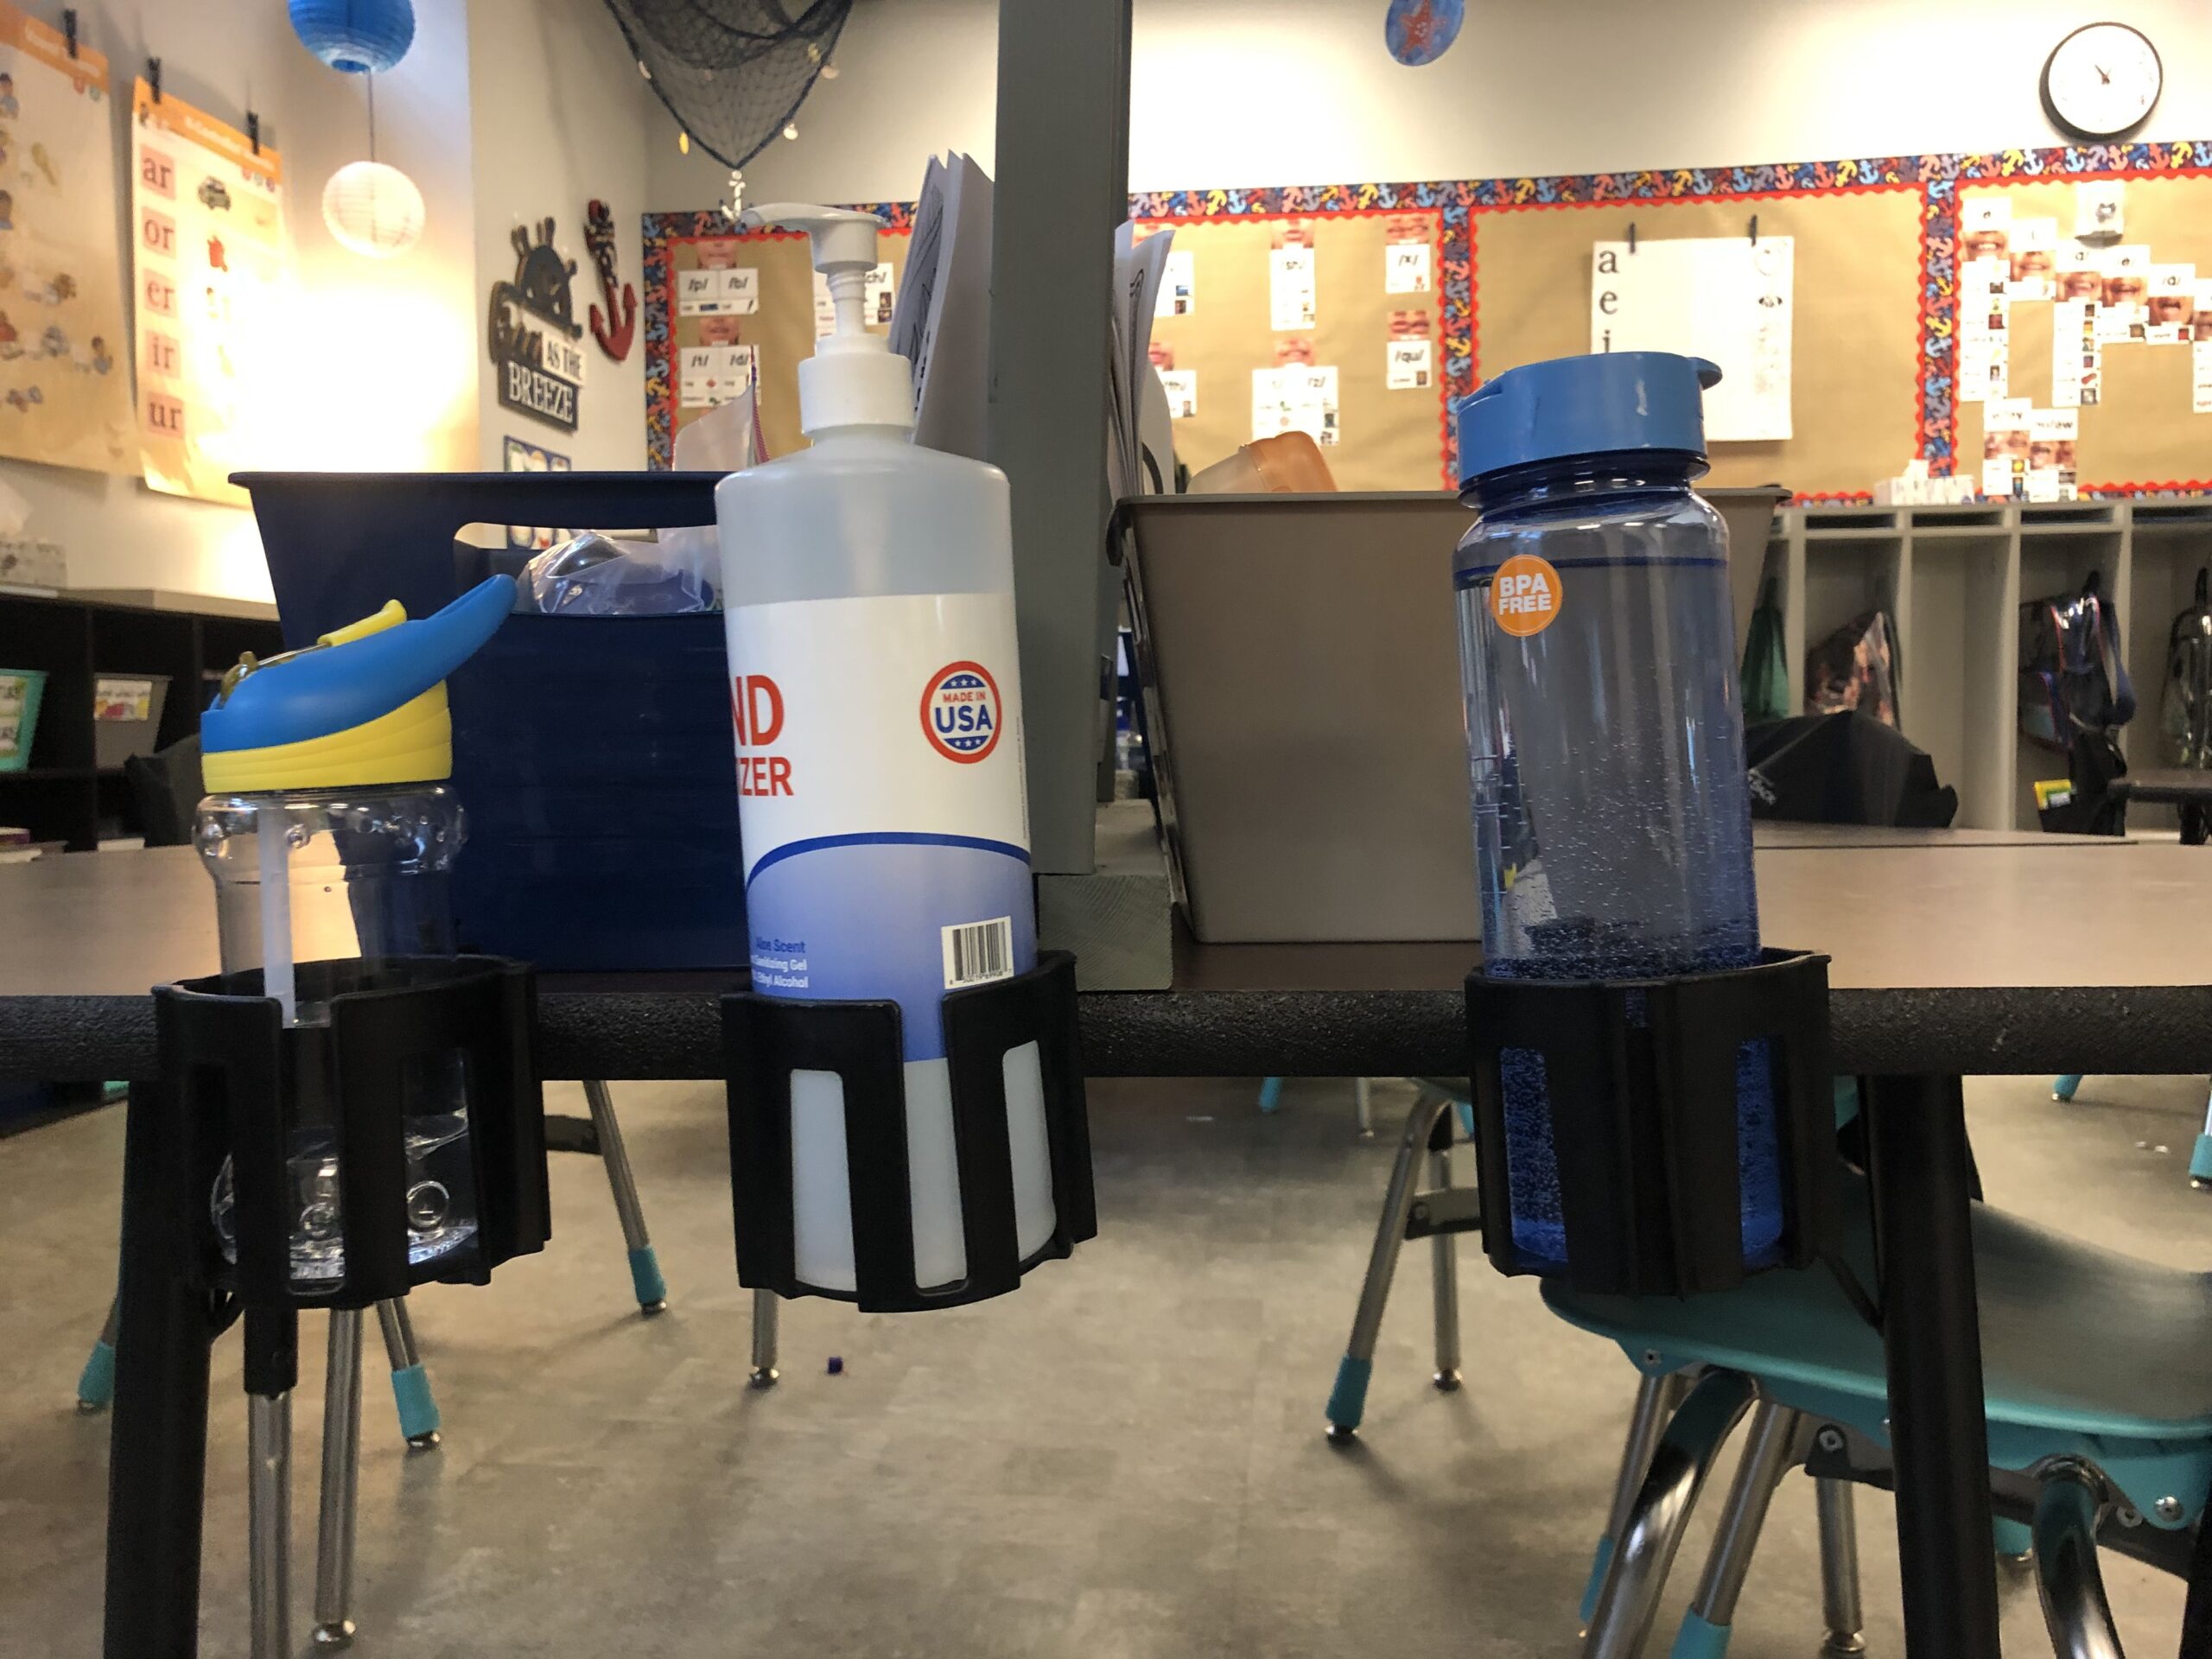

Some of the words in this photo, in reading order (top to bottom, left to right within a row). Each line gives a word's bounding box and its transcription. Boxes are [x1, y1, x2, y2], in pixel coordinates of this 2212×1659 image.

[142, 157, 172, 189] ar
[143, 219, 175, 250] or
[1598, 250, 1619, 274] a
[146, 281, 175, 311] er
[1599, 290, 1618, 315] e
[153, 337, 175, 370] ir
[546, 340, 560, 370] AS
[563, 347, 582, 380] THE
[507, 359, 574, 424] BREEZE
[149, 400, 182, 430] ur
[1499, 573, 1550, 598] BPA
[1498, 594, 1553, 616] FREE
[732, 675, 785, 747] ND
[943, 692, 974, 703] MADE
[976, 691, 987, 701] IN
[935, 704, 994, 734] USA
[774, 939, 806, 954] Scent
[790, 959, 808, 971] Gel
[774, 975, 810, 989] Alcohol
